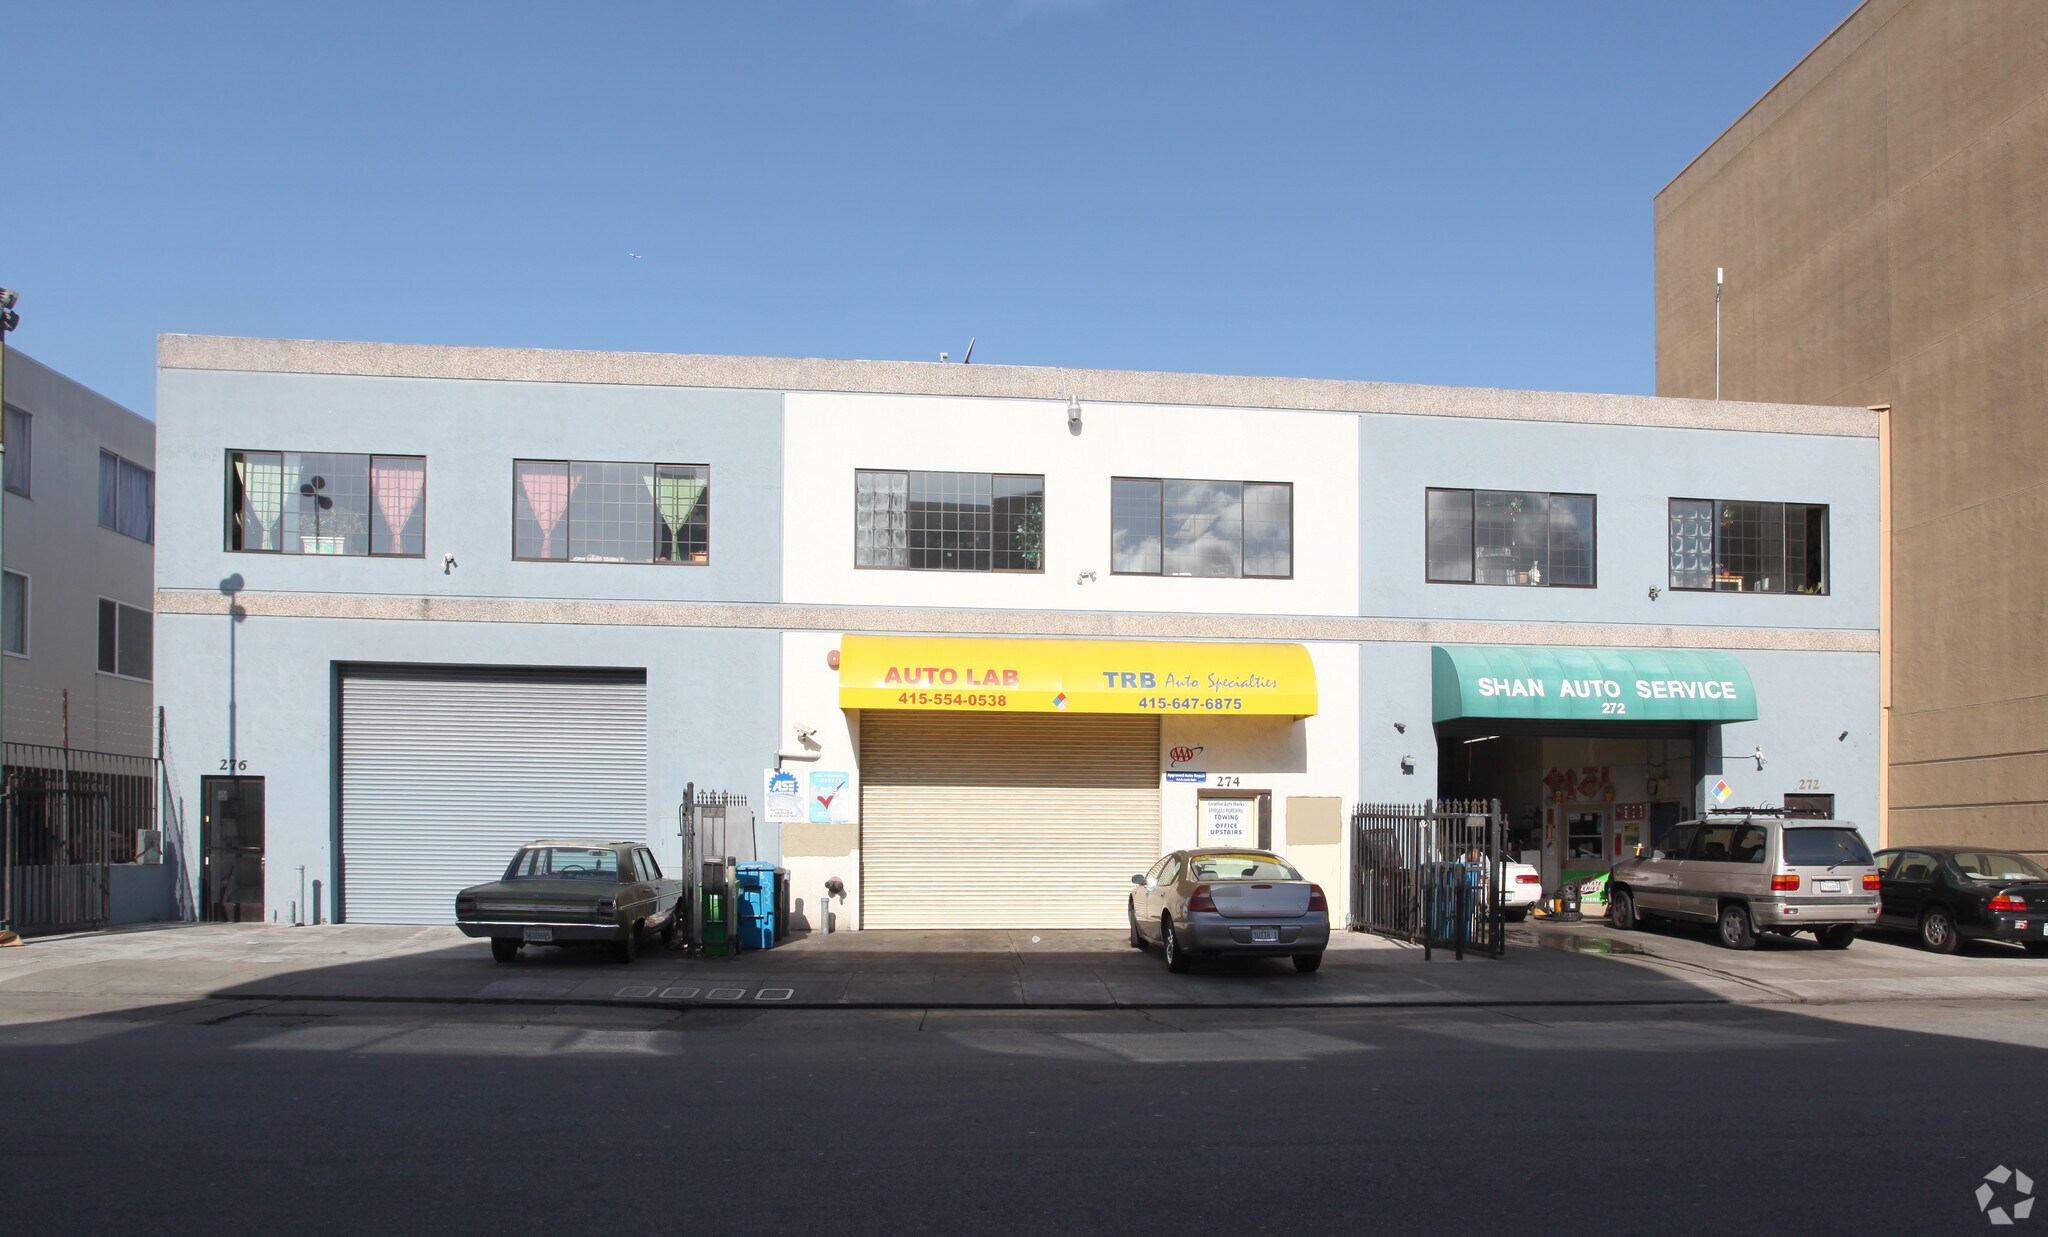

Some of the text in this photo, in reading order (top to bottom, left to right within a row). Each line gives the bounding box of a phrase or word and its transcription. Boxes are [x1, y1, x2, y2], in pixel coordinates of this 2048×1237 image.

[884, 667, 1019, 687] AUTO LAB
[1103, 671, 1278, 693] TRB Auto Specialties
[1478, 677, 1737, 699] SHAN AUTO SERVICE
[898, 692, 1007, 707] 415-554-0538
[1138, 697, 1242, 710] 415-647-6875
[1602, 702, 1626, 714] 272
[1172, 747, 1192, 762] AAA
[219, 759, 248, 771] 276
[772, 780, 794, 791] ASE
[1217, 776, 1240, 787] 274
[1799, 779, 1820, 790] 272
